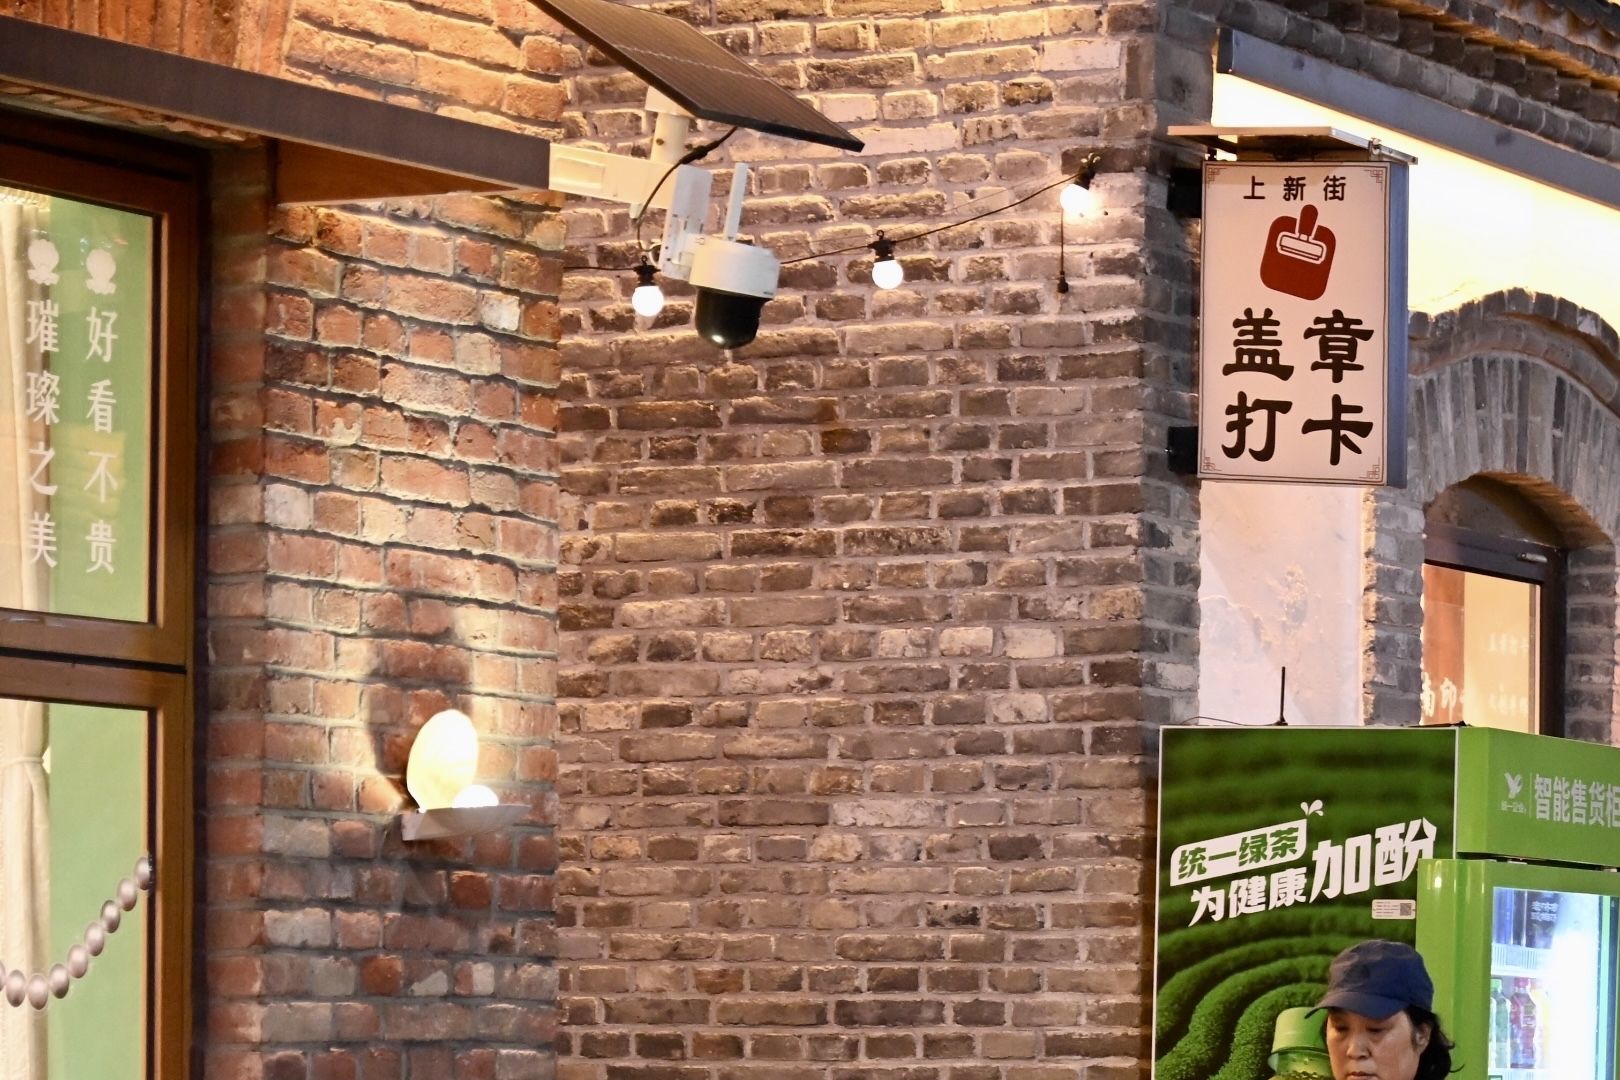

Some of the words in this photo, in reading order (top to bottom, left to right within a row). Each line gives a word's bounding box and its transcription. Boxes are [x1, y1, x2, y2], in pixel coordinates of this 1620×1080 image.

[1243, 175, 1347, 201] 上新街
[1222, 307, 1375, 384] 盖章
[25, 299, 60, 568] 璀璨之美
[84, 306, 119, 575] 好看不贵
[1221, 390, 1375, 466] 打卡
[1178, 826, 1300, 880] 统一绿茶
